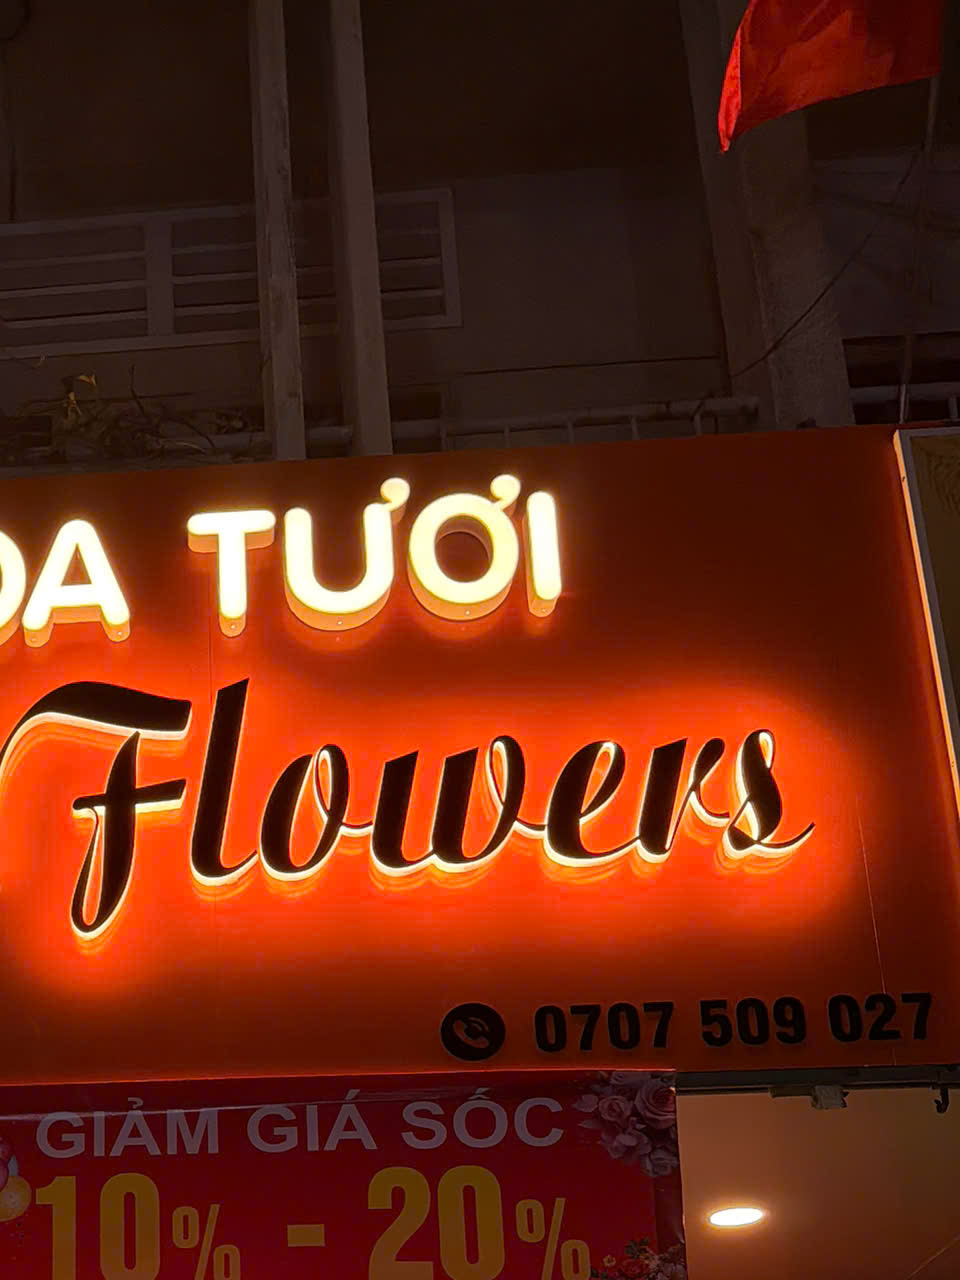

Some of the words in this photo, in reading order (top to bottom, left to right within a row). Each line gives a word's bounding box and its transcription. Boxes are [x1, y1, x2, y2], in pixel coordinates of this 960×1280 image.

[187, 473, 562, 634] TƯƠI
[534, 1001, 674, 1053] 0707
[700, 996, 807, 1047] 509
[828, 992, 933, 1043] 027
[36, 1097, 219, 1158] GIẢM
[246, 1089, 377, 1153] GIÁ
[400, 1087, 565, 1149] SỐC
